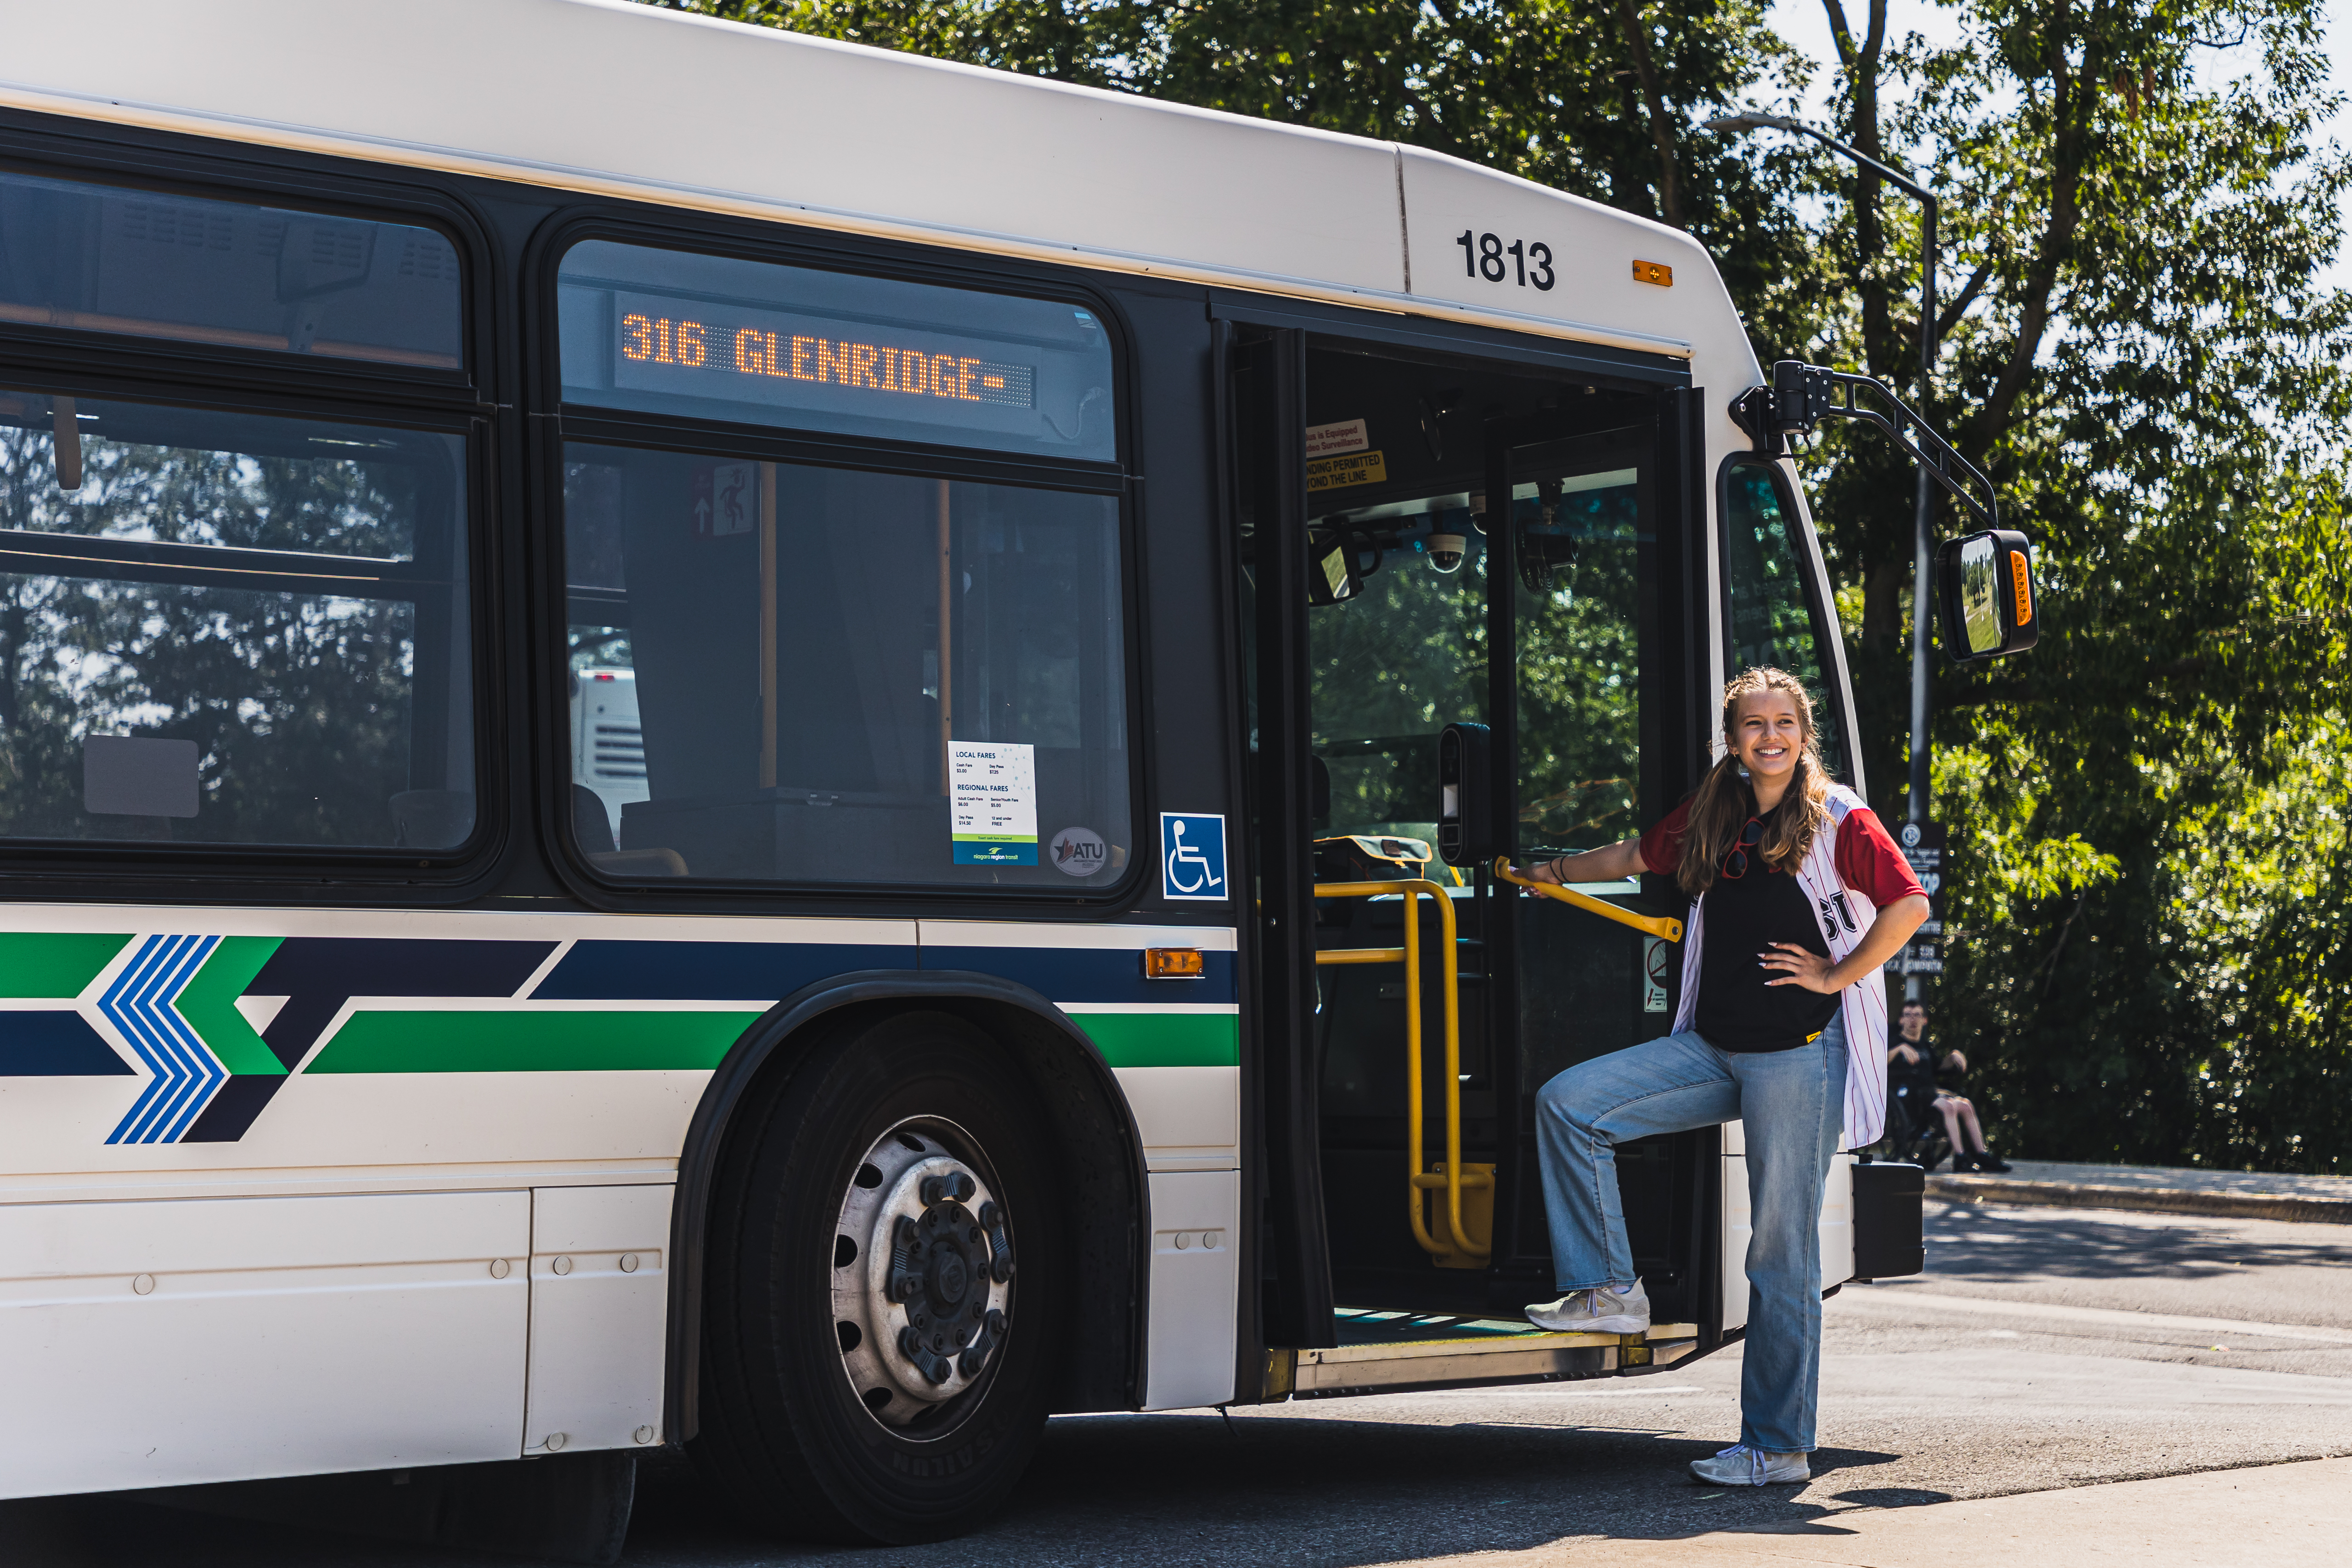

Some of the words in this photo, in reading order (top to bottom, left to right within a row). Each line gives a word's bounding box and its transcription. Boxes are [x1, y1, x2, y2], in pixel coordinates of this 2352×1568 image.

[1457, 229, 1555, 291] 1813
[624, 314, 705, 366] 316
[1325, 425, 1358, 438] Equipped
[1321, 438, 1363, 450] Surveillance
[1306, 462, 1332, 475] NDING
[1333, 454, 1380, 471] PERMITTED
[1307, 476, 1328, 488] YOND
[1330, 473, 1346, 485] THE
[1348, 470, 1367, 482] LINE
[1072, 842, 1103, 859] ATU
[892, 1428, 993, 1477] SAILUN
